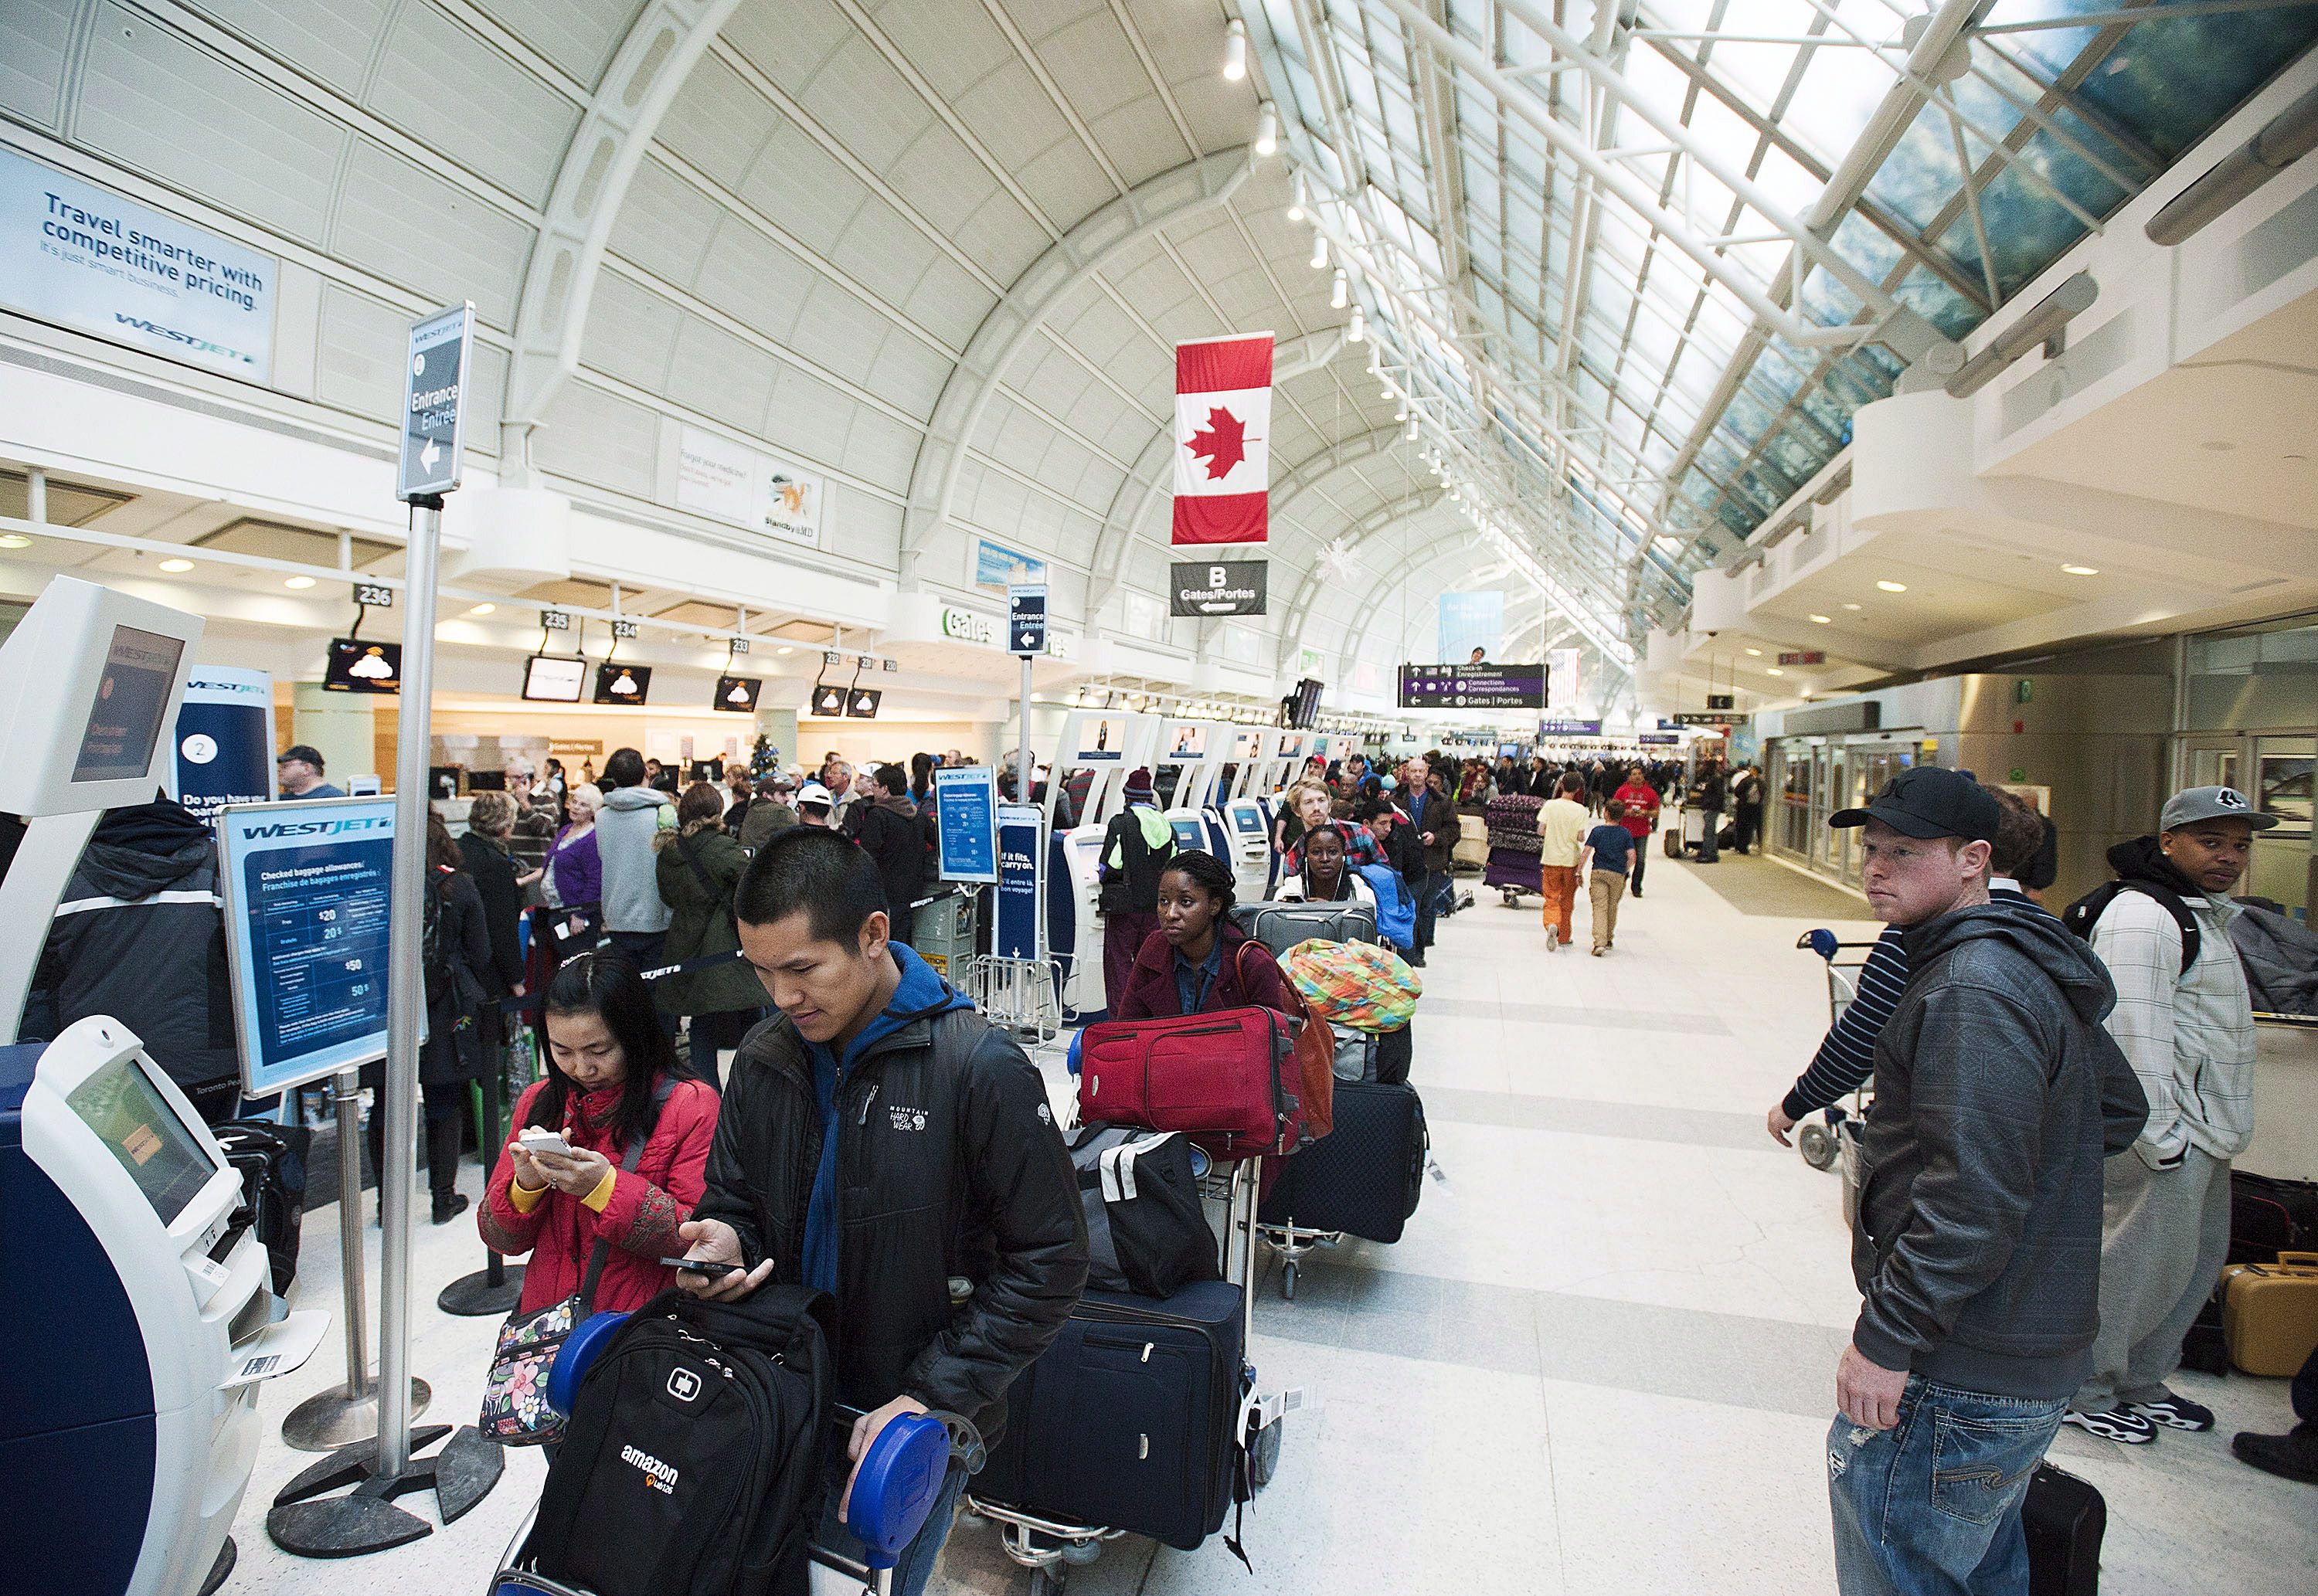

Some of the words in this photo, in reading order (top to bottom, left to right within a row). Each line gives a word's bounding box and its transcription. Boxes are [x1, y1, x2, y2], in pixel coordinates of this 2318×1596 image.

[44, 191, 121, 239] Travel
[128, 229, 216, 272] smarter
[221, 265, 263, 291] with
[40, 239, 59, 256] It's
[60, 246, 85, 264] just
[89, 256, 124, 280] smart
[42, 220, 179, 280] competitive
[185, 271, 257, 311] pricing.
[114, 311, 242, 358] WESTJET
[411, 385, 457, 412] Entrance
[422, 404, 456, 431] Entrée
[1209, 566, 1226, 588] B
[359, 586, 392, 606] 236
[1180, 587, 1256, 601] Gates/Portes
[545, 612, 569, 629] 235
[1012, 612, 1043, 620] Entrance
[615, 622, 636, 637] 234
[943, 607, 992, 643] Gates
[1020, 620, 1043, 629] Entrée
[733, 639, 748, 652] 233
[827, 653, 839, 664] 232
[862, 657, 872, 668] 231
[195, 742, 205, 757] 2
[183, 794, 201, 805] Do
[203, 795, 226, 806] you
[243, 817, 379, 840] WESTJET
[1001, 852, 1007, 861] If
[1015, 853, 1030, 863] fits,
[1001, 861, 1021, 871] carry
[261, 869, 294, 881] Checked
[294, 866, 325, 877] baggage
[263, 880, 299, 891] Franchise
[310, 875, 339, 885] bagages
[318, 909, 336, 921] $20
[324, 928, 336, 939] 20
[345, 959, 362, 971] $50
[352, 984, 364, 996] 50
[196, 1083, 227, 1095] Toronto
[889, 1105, 929, 1116] MOUNTAIN
[890, 1112, 909, 1122] HARD
[893, 1121, 913, 1131] WEAR
[620, 1444, 678, 1486] amazon
[654, 1479, 674, 1495] Lab126
